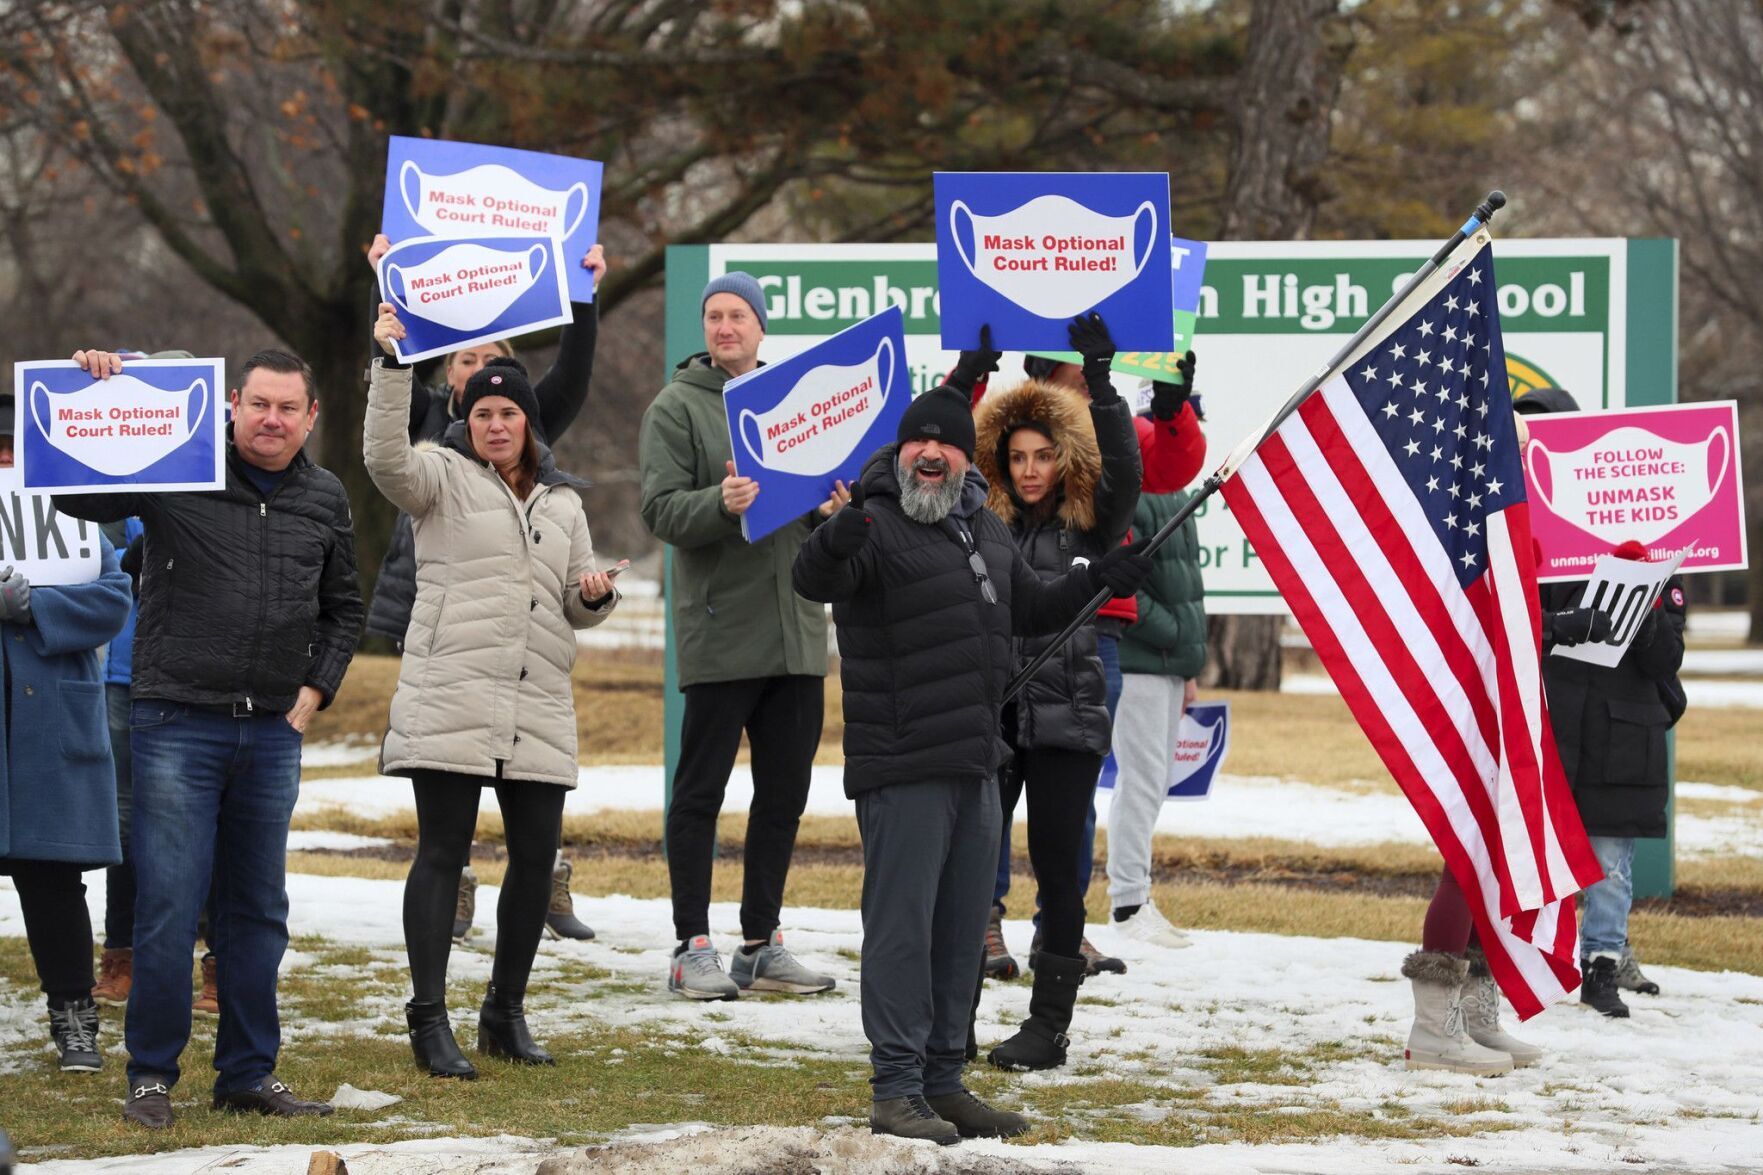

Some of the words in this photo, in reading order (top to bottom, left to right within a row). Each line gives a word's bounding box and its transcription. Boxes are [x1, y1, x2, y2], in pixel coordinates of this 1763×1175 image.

[429, 190, 476, 207] Mask
[482, 196, 558, 218] Optional
[435, 208, 486, 224] Court
[491, 213, 549, 233] Ruled!
[983, 235, 1036, 250] Mask
[1042, 235, 1125, 253] Optional
[993, 256, 1049, 271] Court
[1054, 256, 1118, 272] Ruled!
[410, 273, 452, 290] Mask
[456, 261, 523, 280] Optional
[420, 287, 463, 304] Court
[467, 274, 518, 294] Ruled!
[1242, 273, 1369, 330] High
[58, 407, 104, 421] Mask
[108, 406, 180, 422] Optional
[766, 413, 808, 440] Mask
[810, 376, 874, 418] Optional
[65, 423, 114, 438] Court
[118, 423, 173, 437] Ruled!
[776, 423, 819, 454] Court
[821, 396, 870, 428] Ruled!
[1593, 448, 1664, 464] FOLLOW
[1573, 467, 1607, 481] THE
[1610, 462, 1686, 479] SCIENCE:
[1586, 486, 1676, 506] UNMASK
[1585, 509, 1626, 527] THE
[1631, 505, 1679, 523] KIDS
